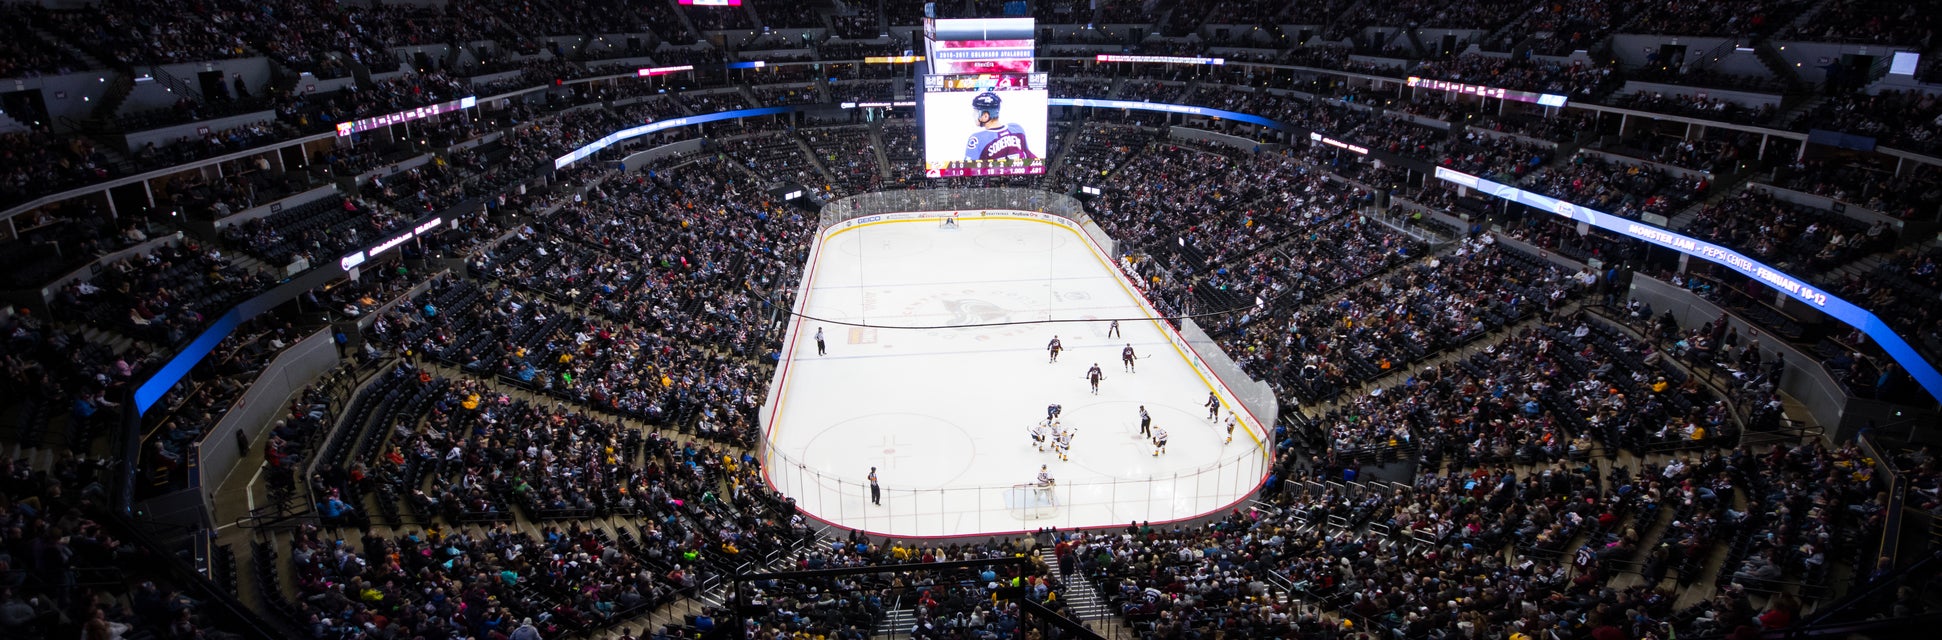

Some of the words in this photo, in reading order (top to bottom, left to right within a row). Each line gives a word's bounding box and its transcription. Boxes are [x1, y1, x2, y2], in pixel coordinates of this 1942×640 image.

[858, 216, 880, 224] GEICO
[1629, 224, 1672, 244] MONSTER
[1674, 238, 1696, 252] JAM
[1703, 246, 1726, 261] PEPSI
[1727, 254, 1752, 272] CENTER
[1757, 268, 1801, 293] FEBRUARY
[1801, 287, 1826, 306] 10-12
